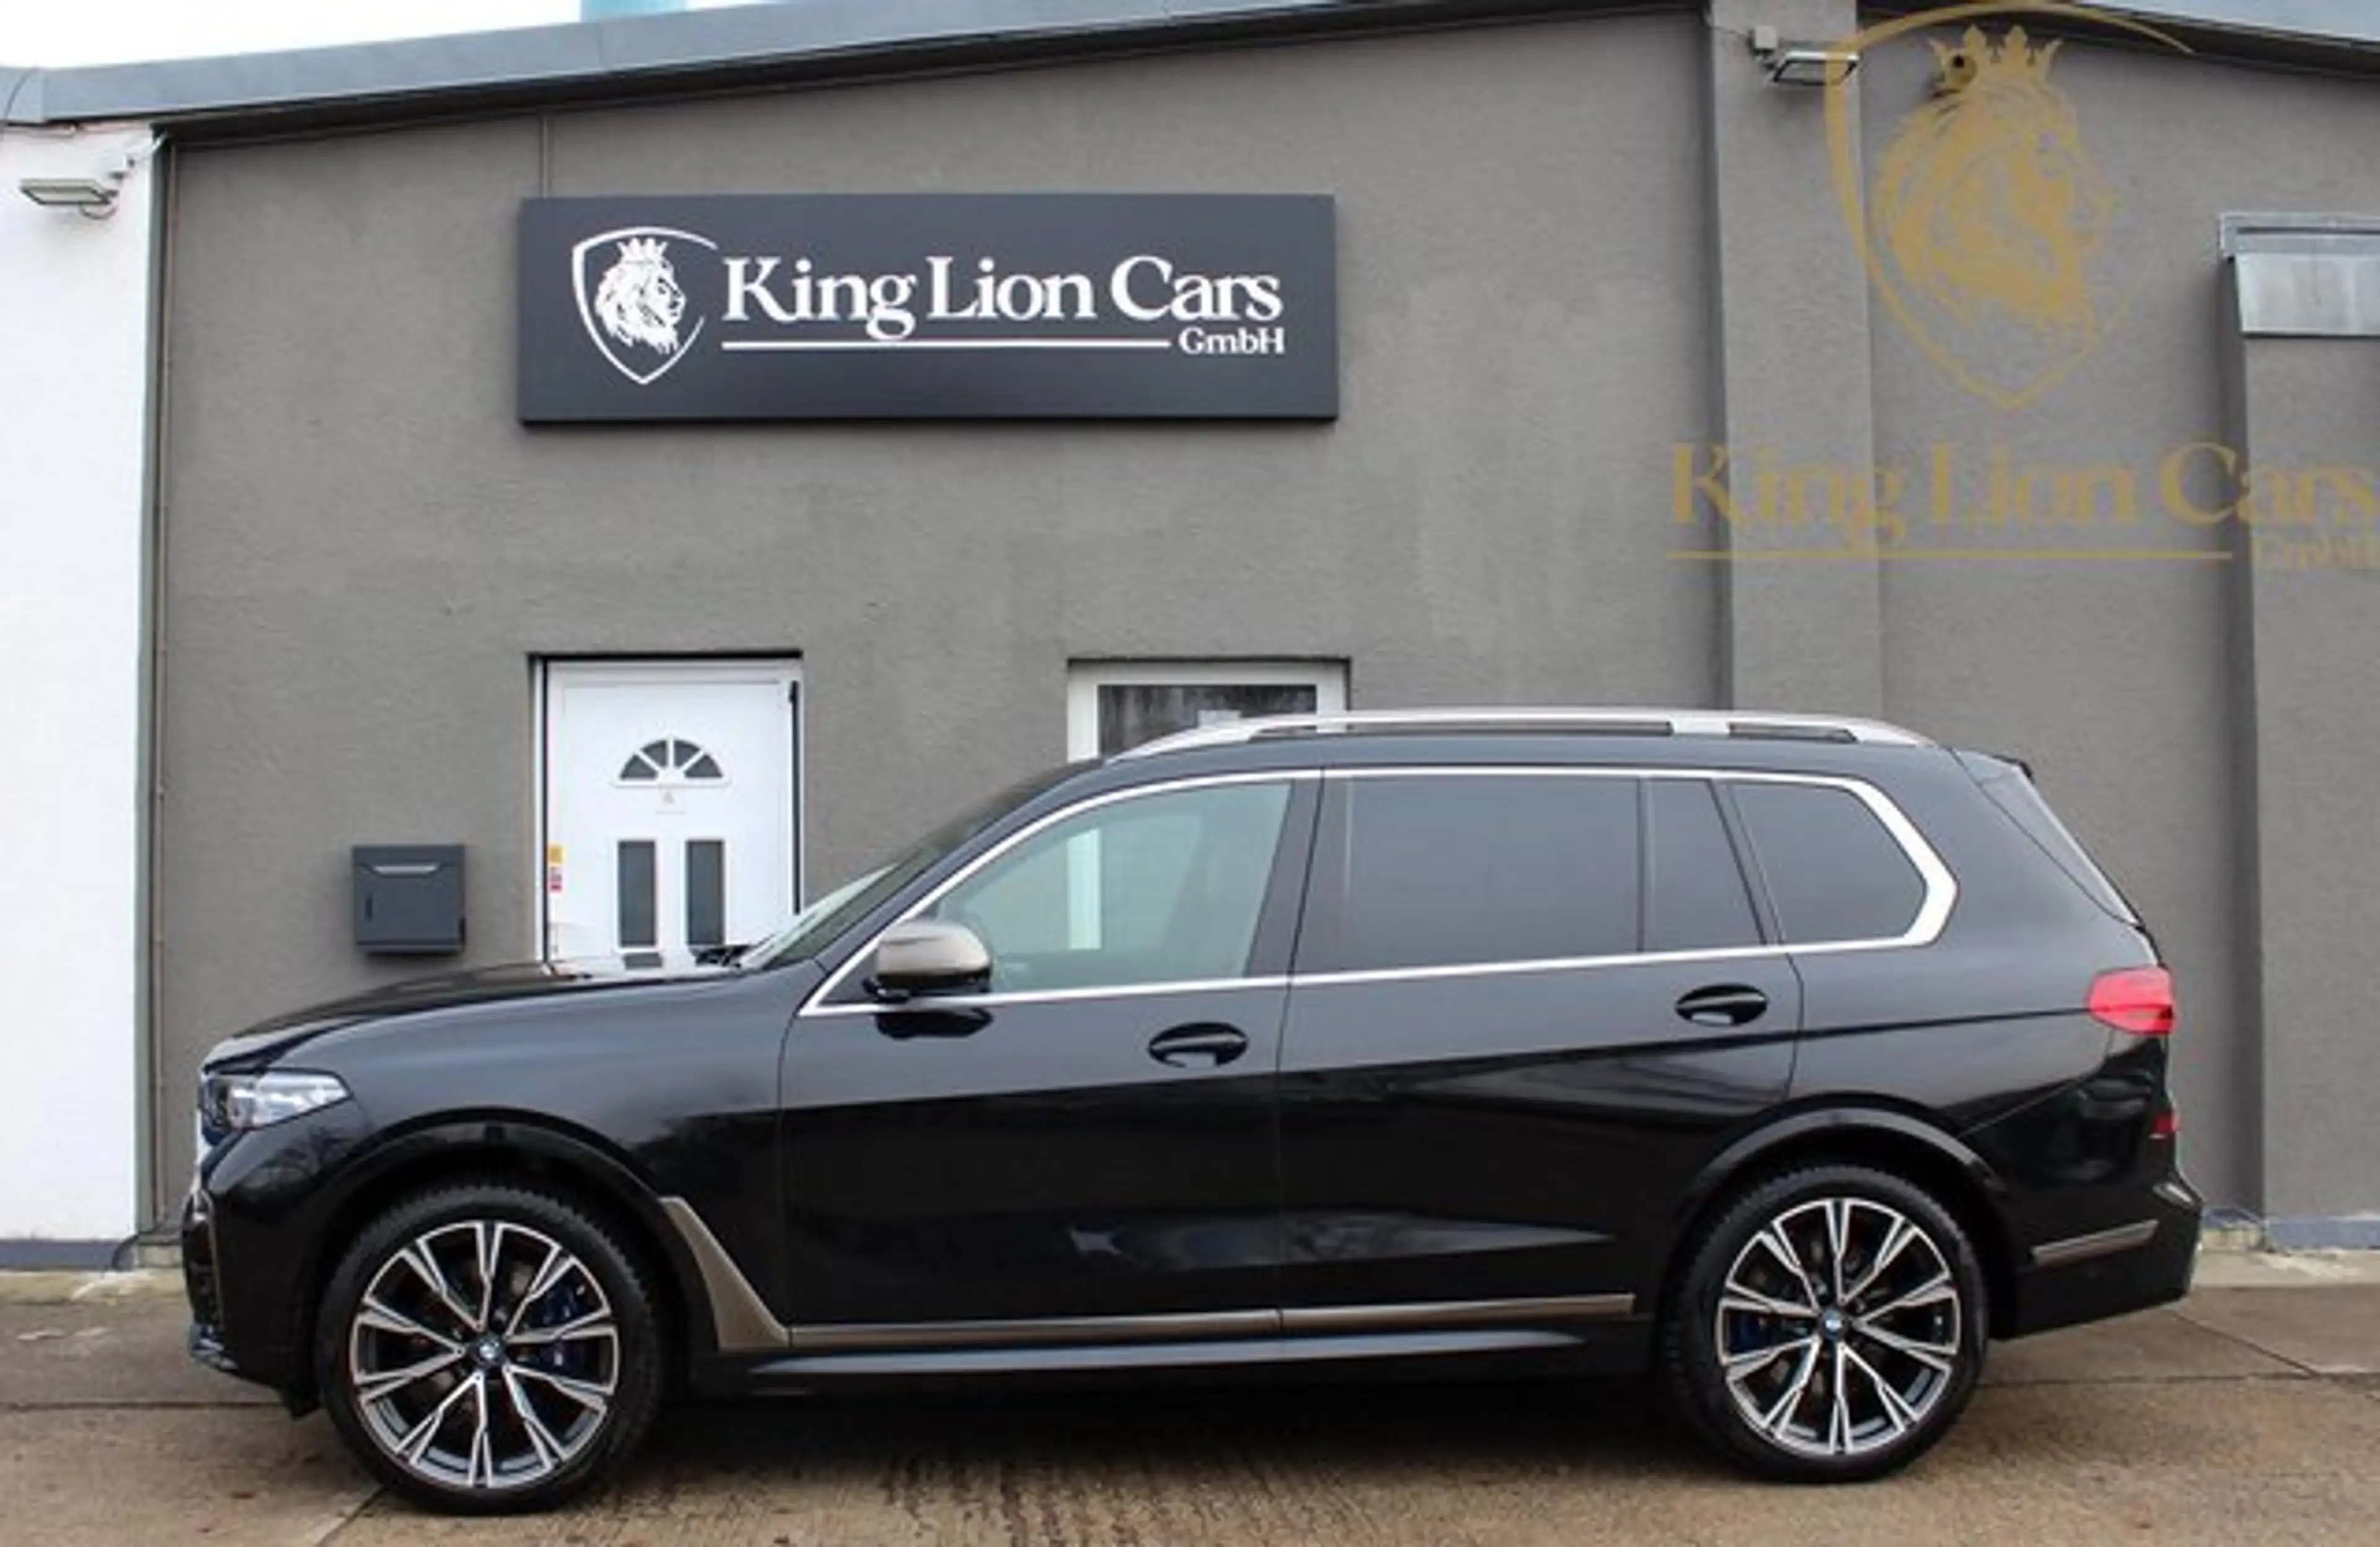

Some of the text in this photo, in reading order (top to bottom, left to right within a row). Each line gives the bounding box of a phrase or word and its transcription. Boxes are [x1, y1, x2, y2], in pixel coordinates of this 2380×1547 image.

[721, 255, 1284, 341] King Lion Cars
[1178, 326, 1285, 355] GmbH
